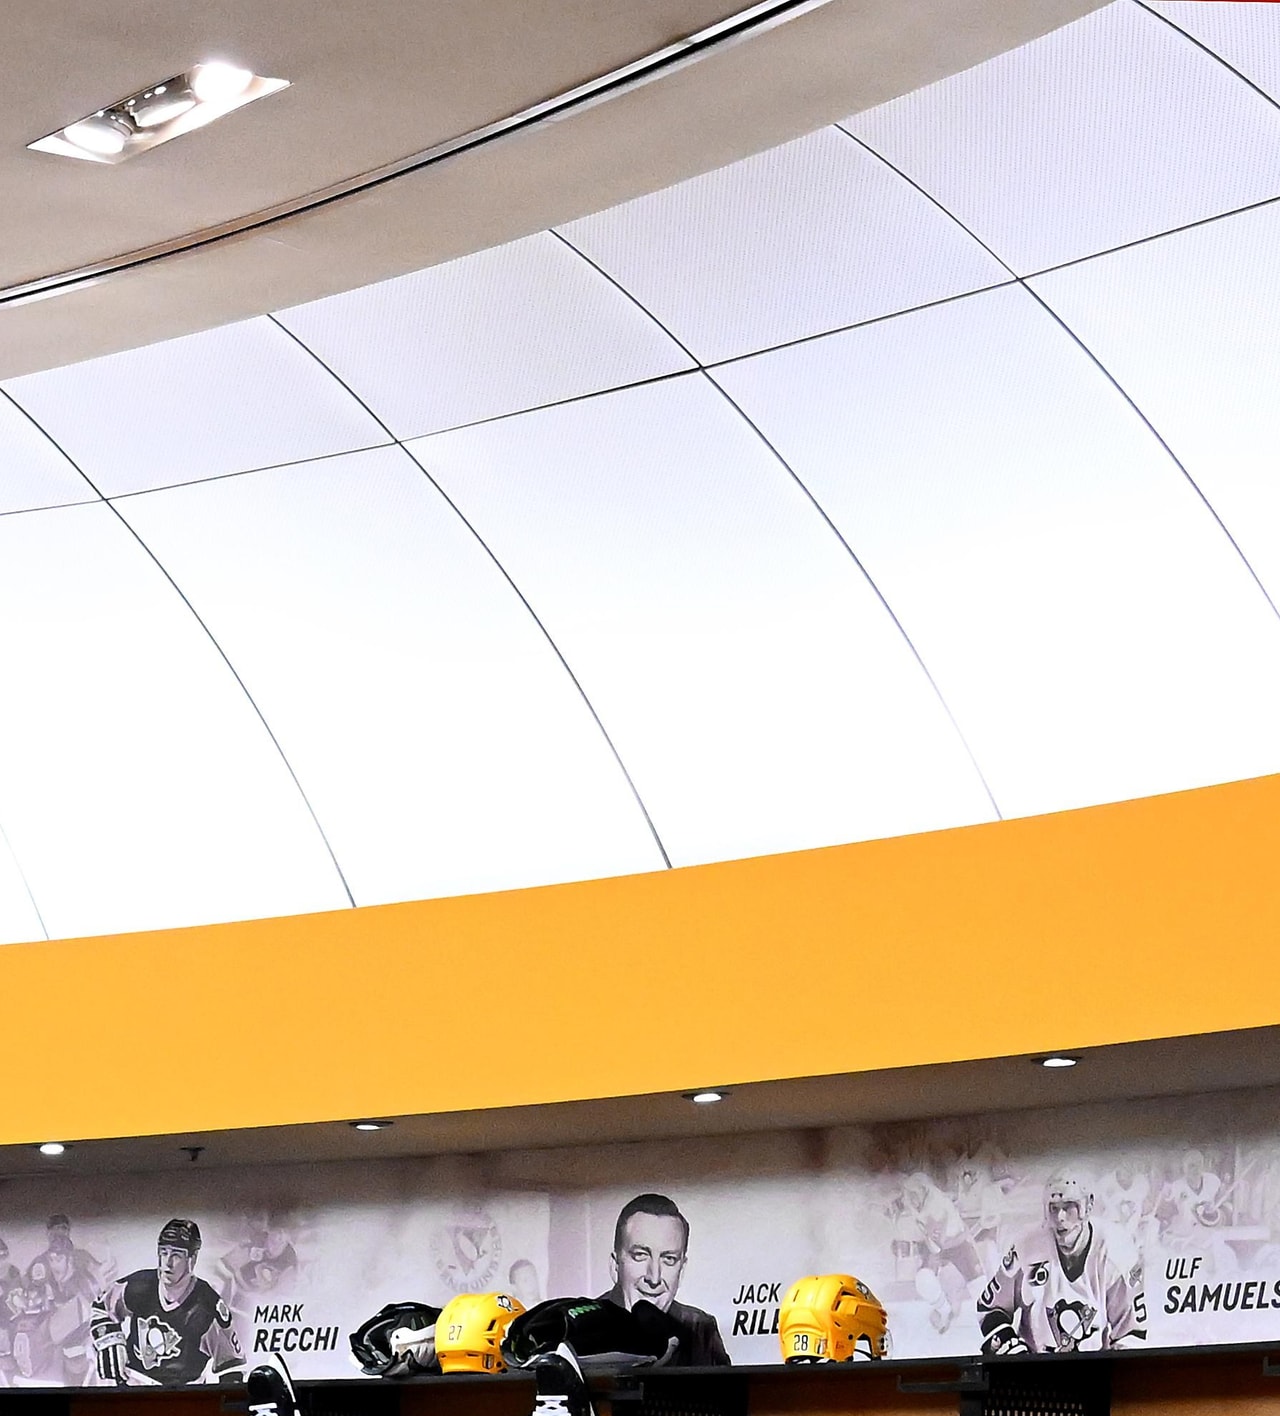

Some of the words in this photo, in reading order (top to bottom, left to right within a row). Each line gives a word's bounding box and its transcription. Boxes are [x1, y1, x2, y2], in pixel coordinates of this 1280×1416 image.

[1164, 1257, 1203, 1279] ULF
[732, 1282, 782, 1305] JACK
[253, 1303, 305, 1323] MARK
[253, 1326, 339, 1353] RECCHI
[448, 1325, 462, 1341] 27
[793, 1334, 809, 1351] 28
